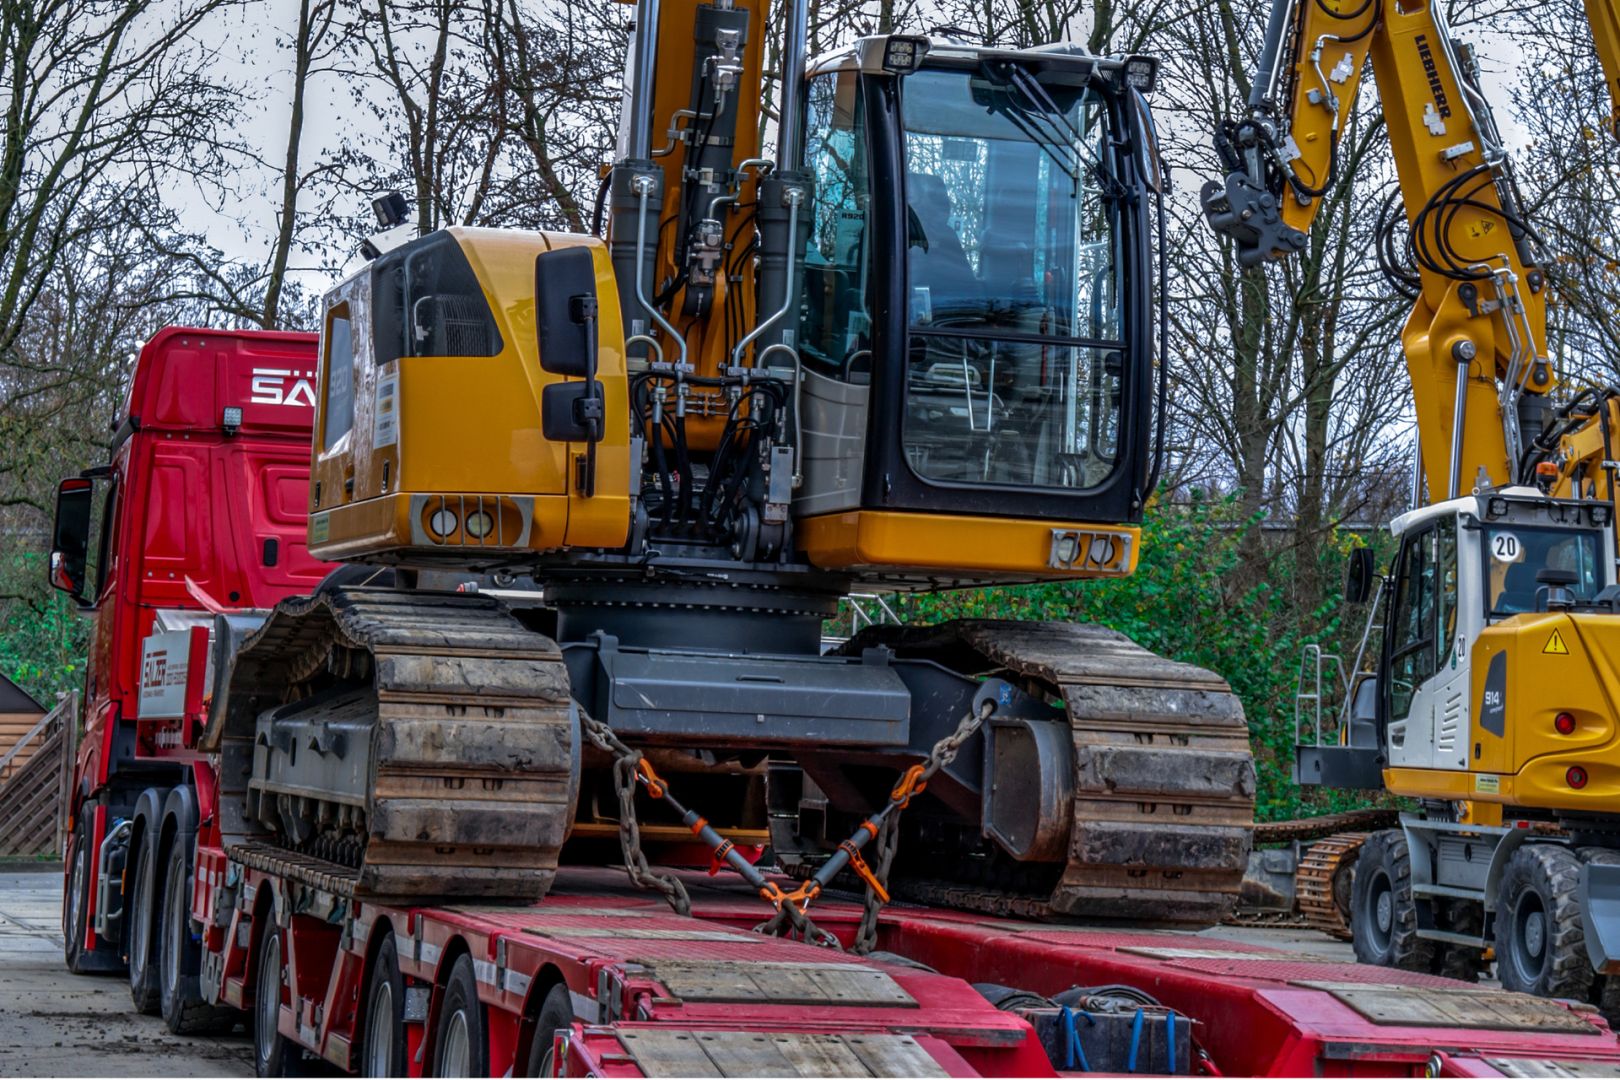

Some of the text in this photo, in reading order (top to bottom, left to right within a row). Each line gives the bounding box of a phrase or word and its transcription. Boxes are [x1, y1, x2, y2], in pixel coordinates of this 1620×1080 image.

[1414, 34, 1452, 120] LIEBHERR
[329, 364, 348, 399] 920
[1496, 536, 1516, 556] 20
[1458, 637, 1466, 657] 20
[1484, 691, 1500, 705] 914
